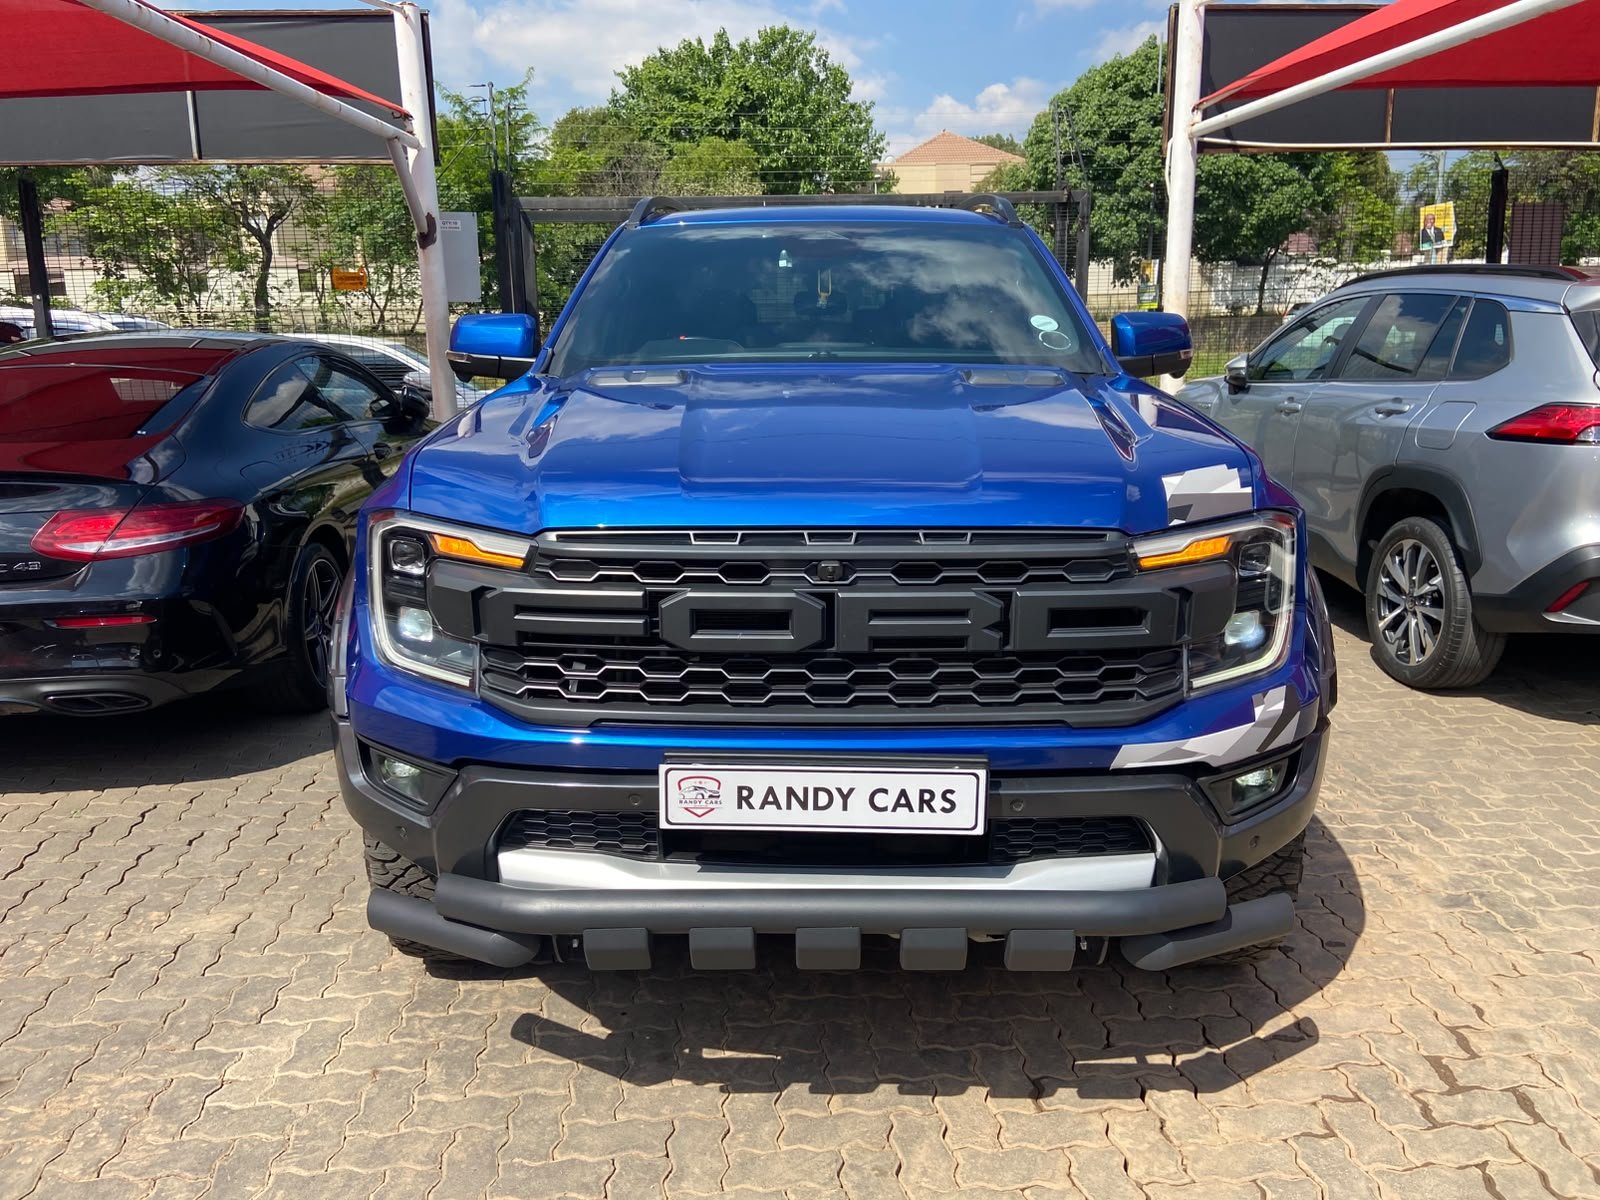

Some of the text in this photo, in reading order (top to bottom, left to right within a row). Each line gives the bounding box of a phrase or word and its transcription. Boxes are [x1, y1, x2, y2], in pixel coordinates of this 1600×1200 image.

[13, 561, 41, 571] 43
[480, 586, 1180, 653] FORD
[736, 785, 957, 814] RANDY CARS
